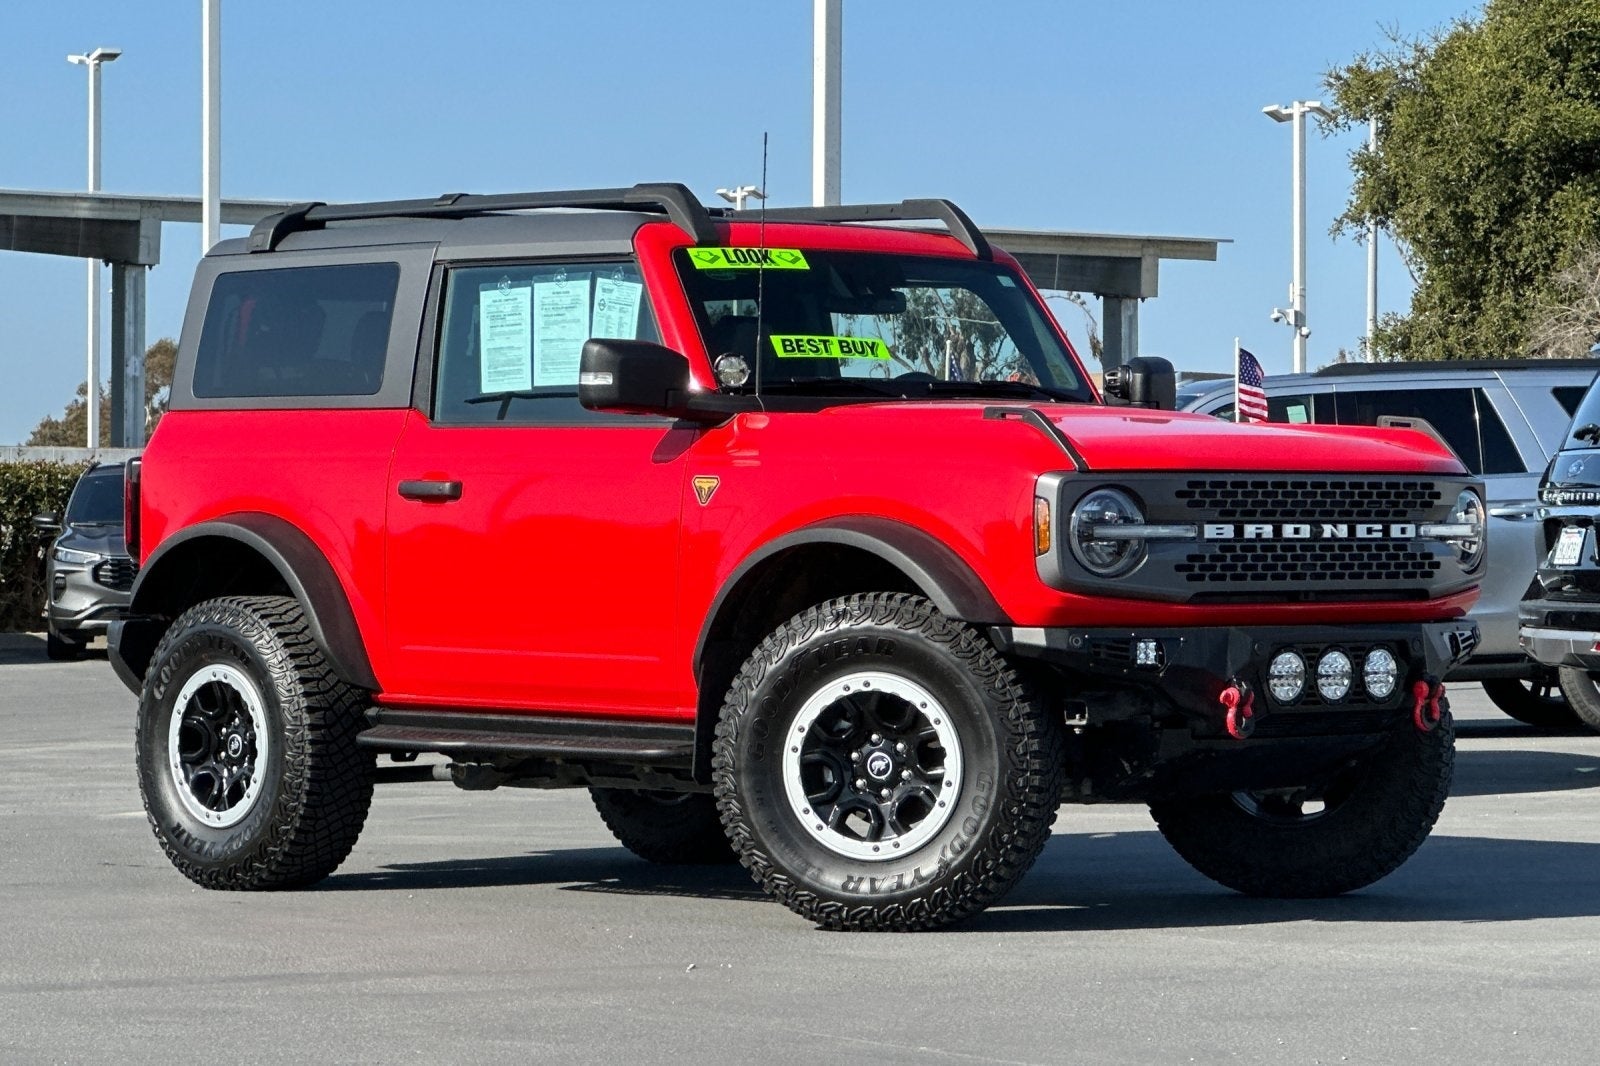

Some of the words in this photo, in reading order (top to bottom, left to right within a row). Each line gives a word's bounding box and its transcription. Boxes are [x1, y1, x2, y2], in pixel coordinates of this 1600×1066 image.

[720, 248, 778, 266] LOOK
[781, 338, 832, 355] BEST
[838, 339, 880, 357] BUY
[1203, 523, 1416, 539] BRONCO
